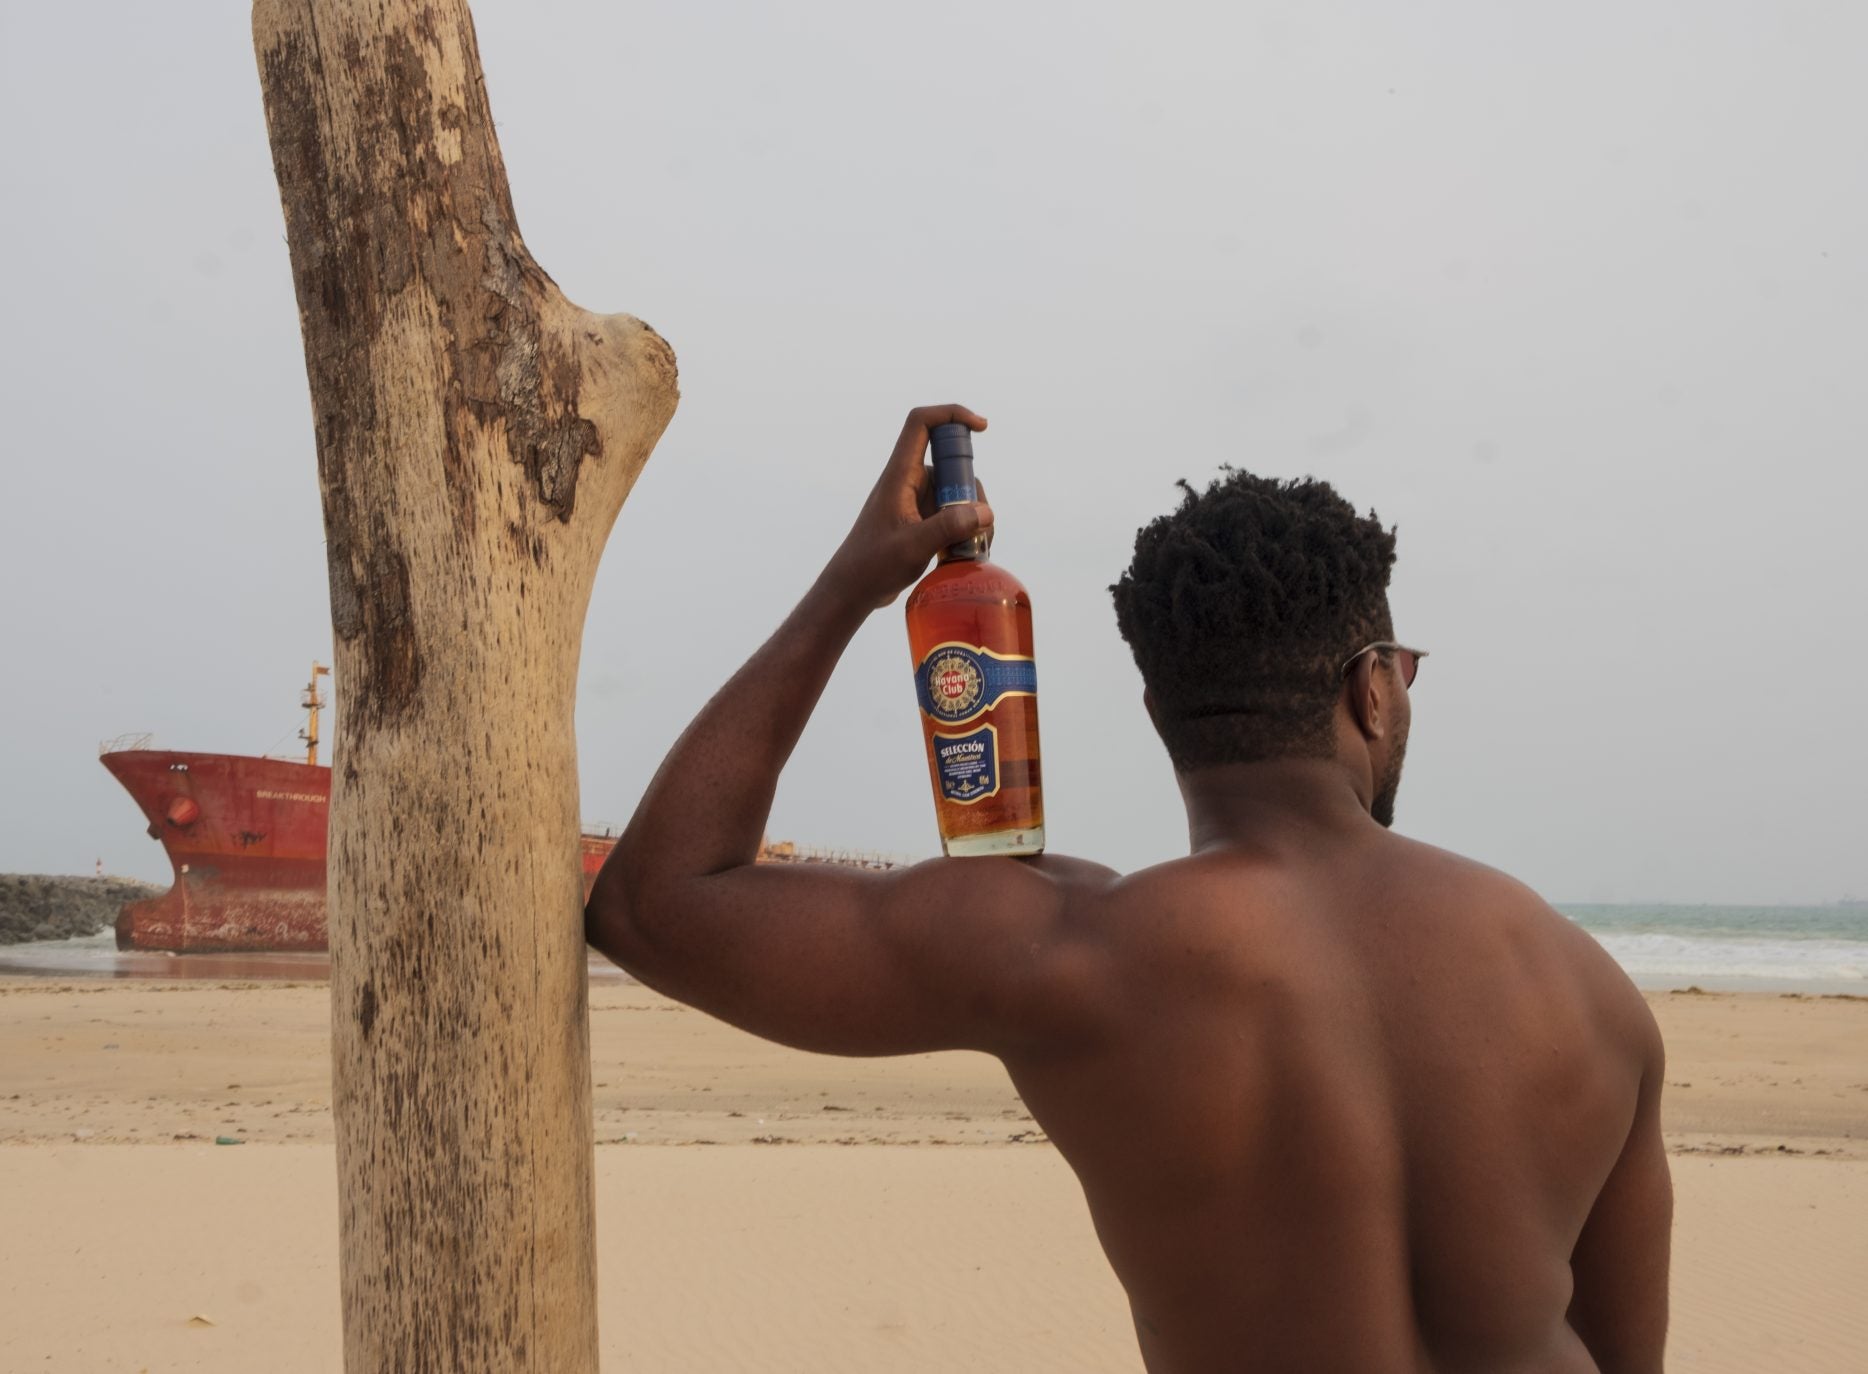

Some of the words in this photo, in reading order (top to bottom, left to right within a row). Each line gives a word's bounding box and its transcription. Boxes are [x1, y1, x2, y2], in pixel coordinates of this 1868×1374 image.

[935, 673, 969, 686] Havana
[942, 684, 963, 695] Club
[940, 740, 985, 758] SELECCIÓN
[256, 789, 327, 804] BREAKTHROUGH
